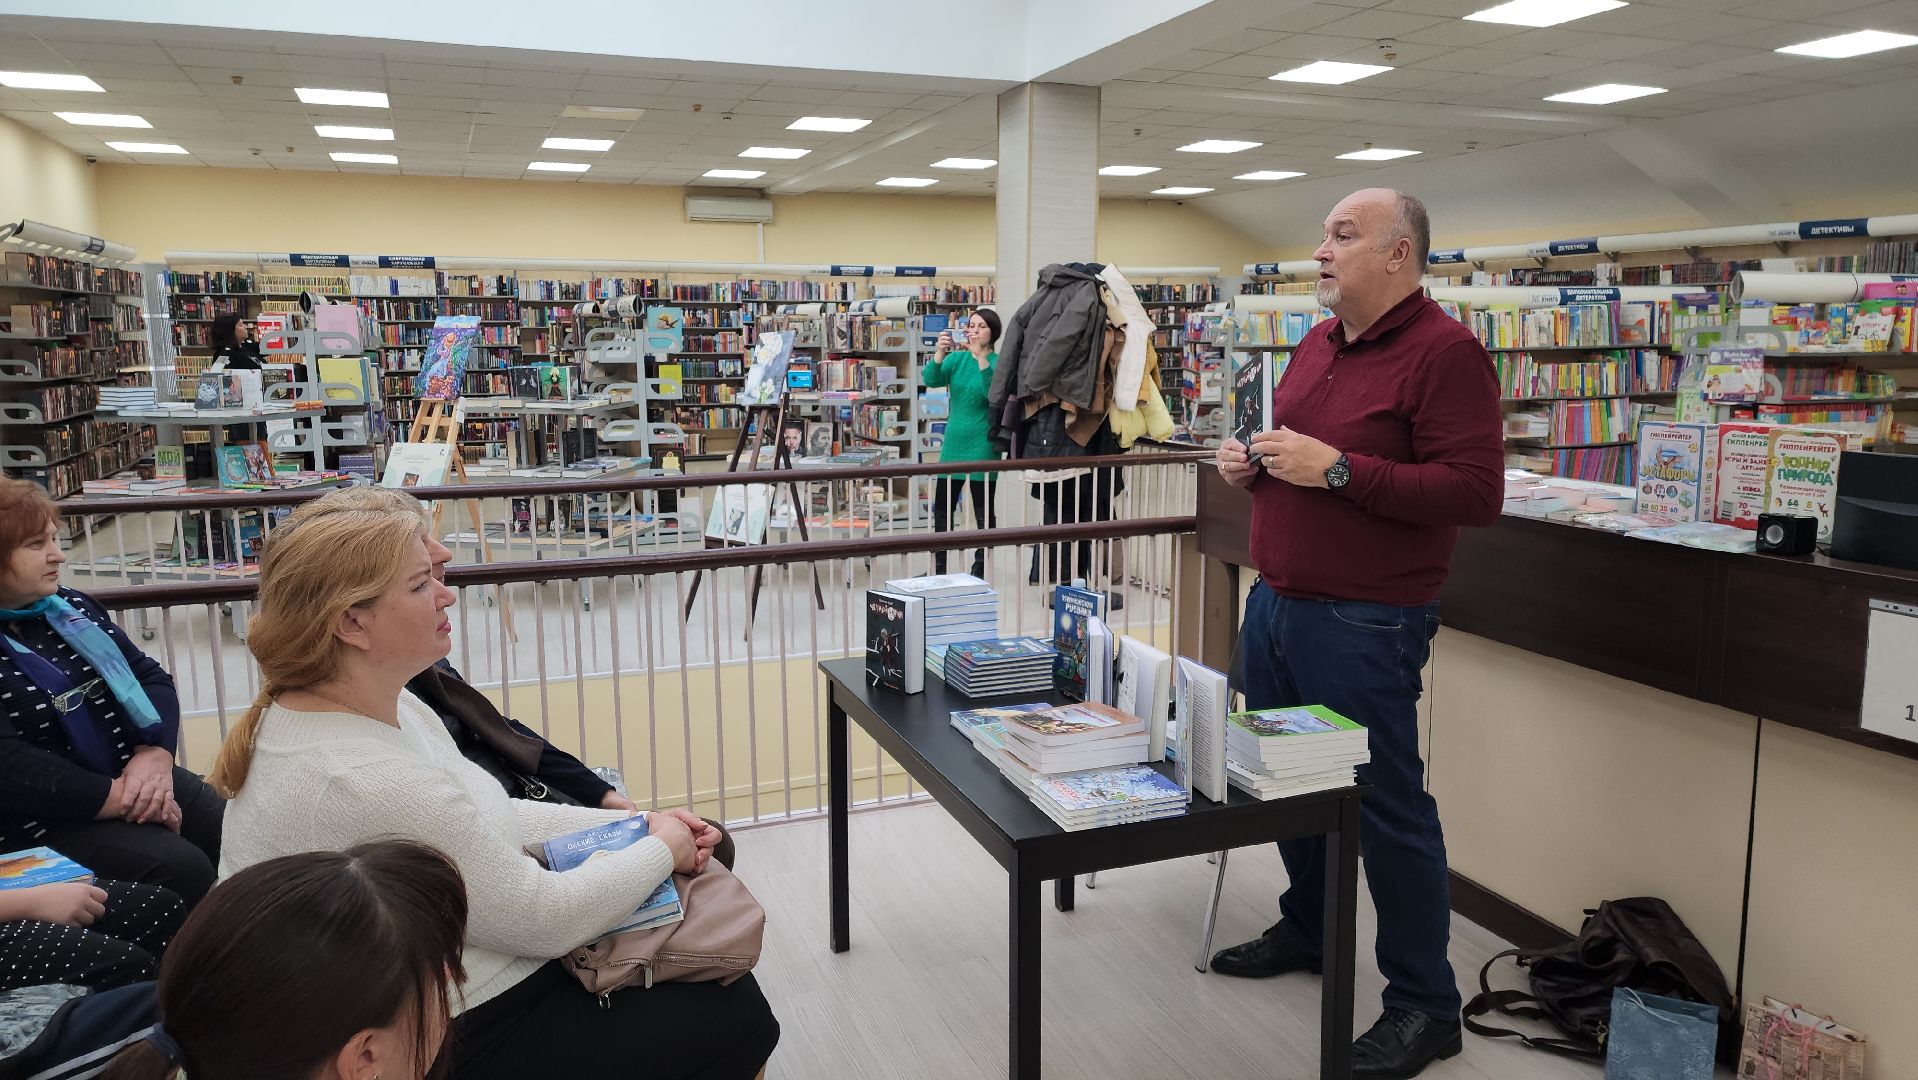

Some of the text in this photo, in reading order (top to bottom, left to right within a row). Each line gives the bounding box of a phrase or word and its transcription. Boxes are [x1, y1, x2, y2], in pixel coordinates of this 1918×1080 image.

[1811, 225, 1855, 235] ДЕТЕКТИВЫ
[1557, 243, 1589, 252] ДЕТЕКТИВЫ
[1650, 432, 1692, 440] ГИППЕНРЕЙТЕР
[1779, 443, 1837, 454] ГИППЕНРЕЙТЕР
[1781, 454, 1832, 473] РОДНАЯ
[1643, 465, 1696, 481] МЕТАФОРЫ
[1777, 467, 1834, 486] ПРИРОДА
[1787, 498, 1799, 507] 64
[1806, 500, 1812, 509] 8
